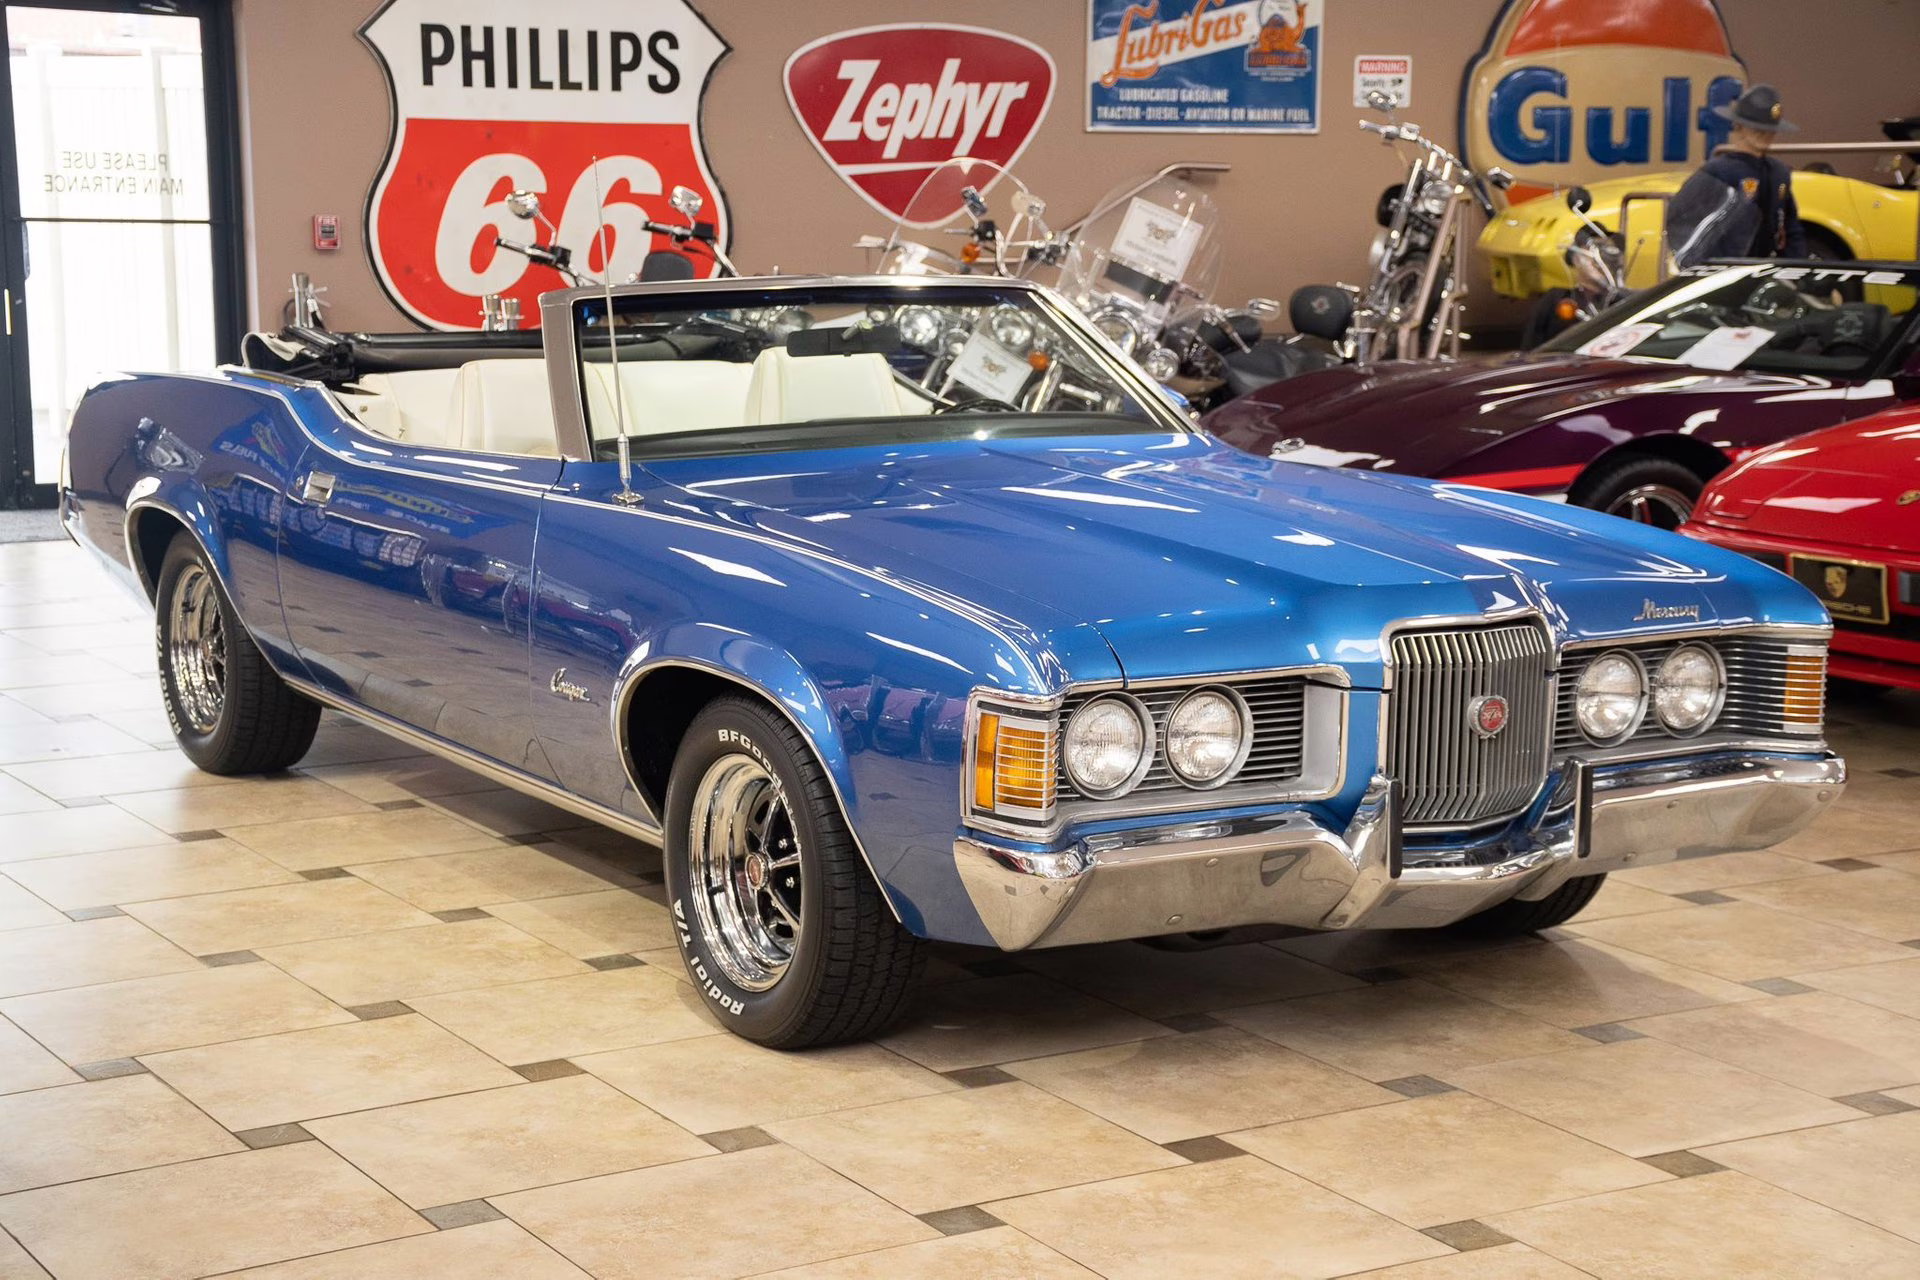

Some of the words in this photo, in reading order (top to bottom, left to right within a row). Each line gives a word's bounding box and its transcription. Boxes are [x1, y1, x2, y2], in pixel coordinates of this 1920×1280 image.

[421, 23, 681, 94] PHILLIPS
[822, 58, 1030, 159] Zephyr
[1097, 106, 1140, 120] TRACTOR
[1146, 106, 1178, 120] DIESEL
[1184, 107, 1230, 121] AVIATION
[1247, 108, 1284, 121] MARINE
[1286, 108, 1309, 121] FUEL
[1119, 88, 1178, 101] LUBRICATED
[1180, 88, 1229, 102] GASOLINE
[1487, 66, 1743, 166] Gulf
[435, 153, 663, 296] 66
[1679, 265, 1905, 285] COVETTE
[673, 899, 692, 948] T/A
[690, 956, 745, 1016] Radial
